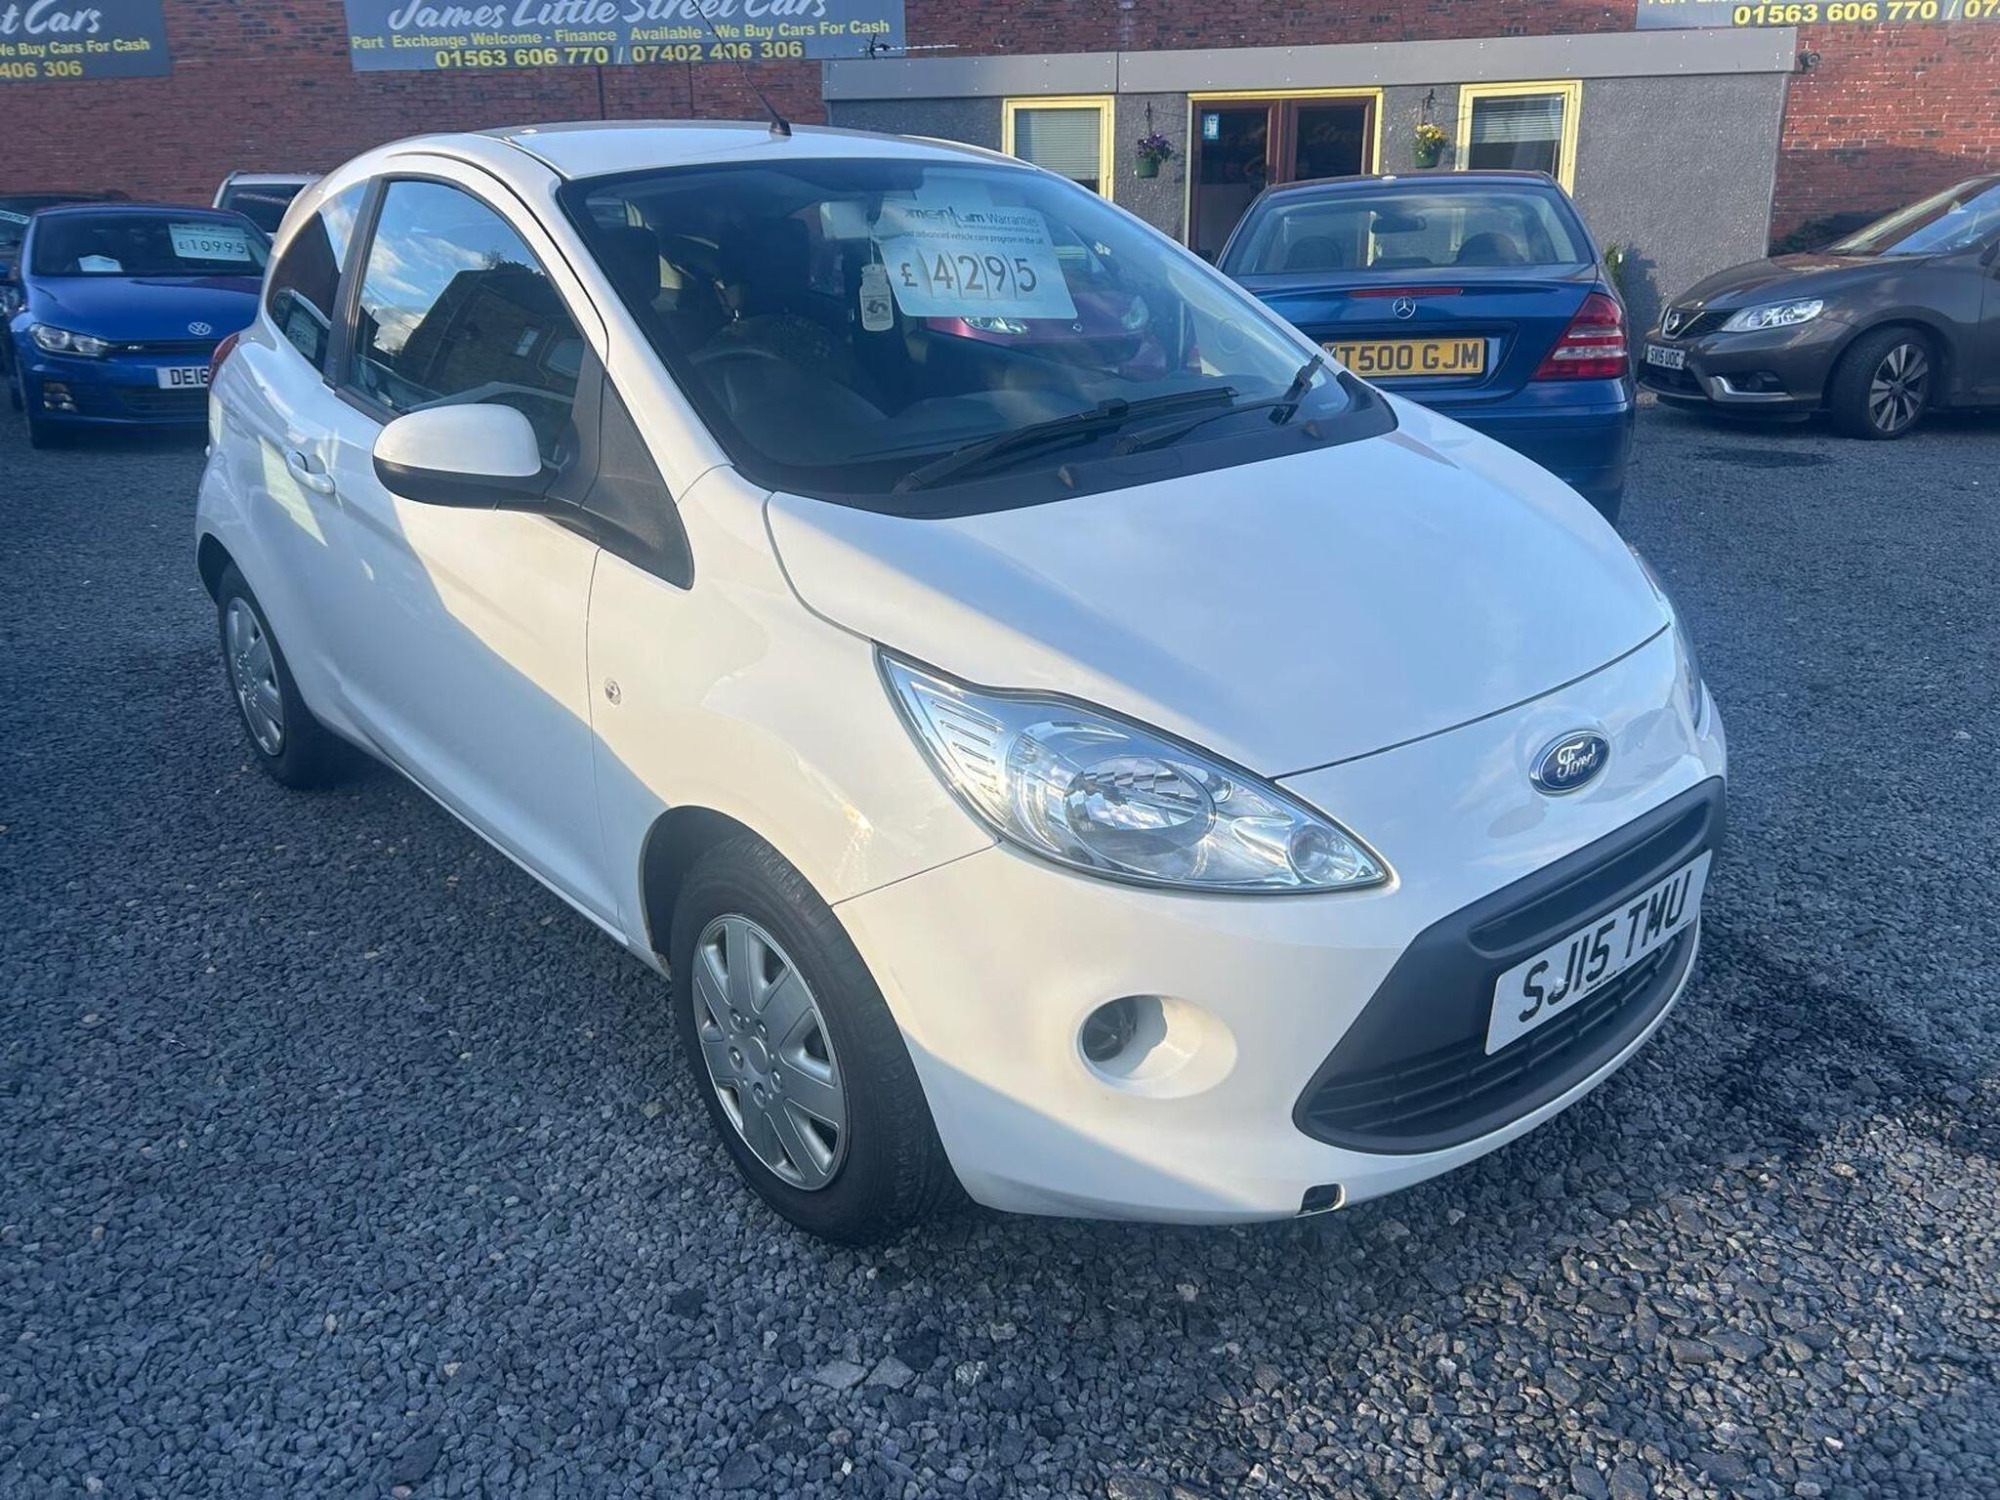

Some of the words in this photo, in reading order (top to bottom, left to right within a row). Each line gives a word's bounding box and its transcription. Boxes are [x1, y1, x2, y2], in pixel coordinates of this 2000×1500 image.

[24, 0, 102, 34] Cars
[387, 0, 506, 30] James
[512, 0, 620, 26] Little
[1733, 4, 1818, 25] 01563
[1826, 2, 1878, 23] 606
[1886, 0, 1938, 20] 770
[18, 42, 46, 58] Buy
[50, 41, 84, 55] Cars
[85, 39, 111, 52] For
[112, 38, 150, 51] Cash
[351, 35, 385, 49] Part
[392, 34, 467, 48] Exchange
[470, 32, 543, 46] Welcome
[554, 29, 618, 43] Finance
[630, 26, 703, 41] Available
[714, 24, 740, 38] We
[744, 24, 774, 40] Buy
[778, 23, 816, 37] Cars
[819, 21, 846, 35] For
[849, 20, 890, 34] Cash
[0, 62, 38, 78] 406
[43, 60, 83, 77] 306
[434, 49, 507, 68] 01563
[514, 48, 559, 66] 606
[563, 46, 609, 65] 770
[631, 44, 703, 63] 07402
[709, 42, 753, 60] 406
[760, 41, 803, 59] 306
[1339, 344, 1413, 371] T500
[1422, 342, 1479, 369] GJM
[1557, 741, 1599, 780] Ford
[1518, 919, 1616, 1023] SJ15
[1624, 869, 1692, 960] TMU
